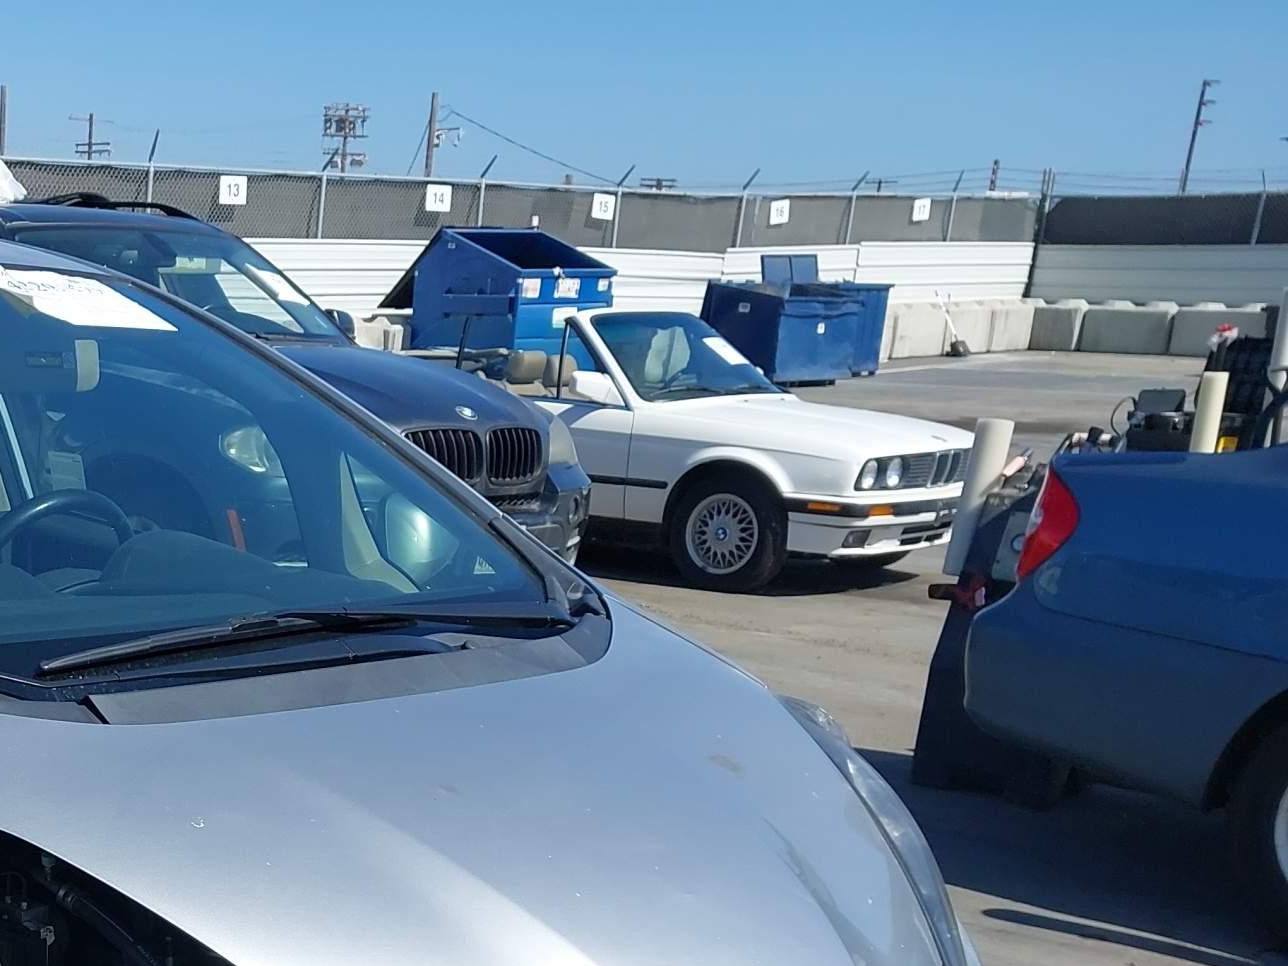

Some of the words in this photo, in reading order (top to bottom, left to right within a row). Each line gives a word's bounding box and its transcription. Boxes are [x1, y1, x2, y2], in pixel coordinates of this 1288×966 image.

[227, 183, 240, 197] 13
[433, 192, 444, 205] 14
[599, 200, 609, 213] 15
